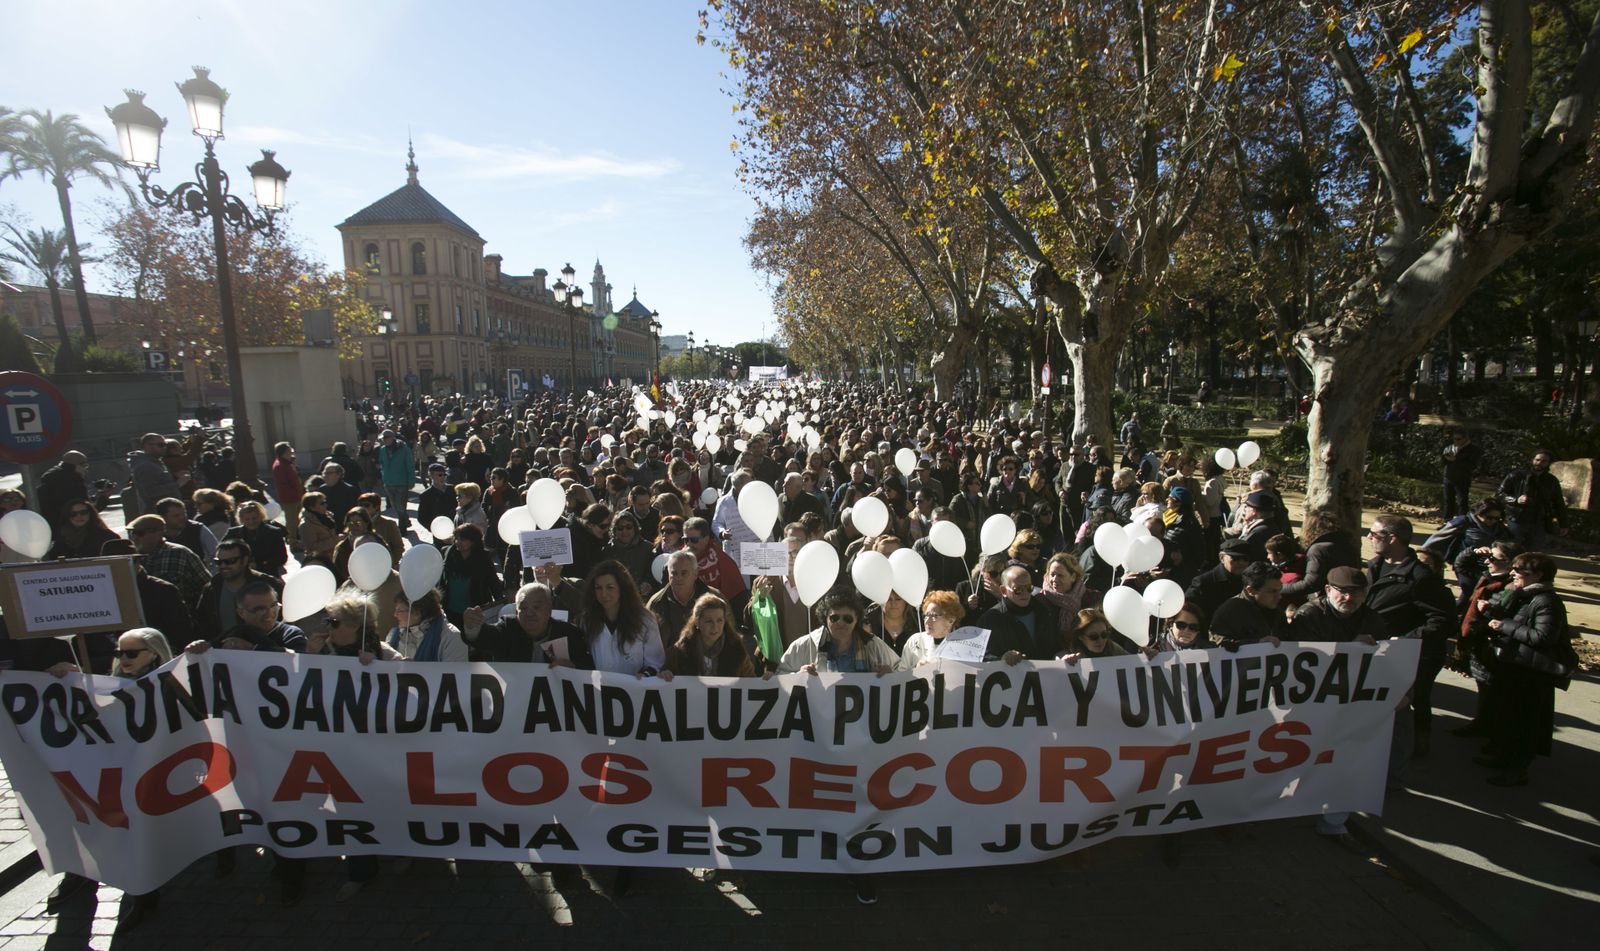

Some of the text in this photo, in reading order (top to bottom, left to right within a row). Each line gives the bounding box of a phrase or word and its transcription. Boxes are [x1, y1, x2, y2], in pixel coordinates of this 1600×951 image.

[150, 352, 165, 368] P
[511, 373, 520, 398] P
[14, 407, 36, 431] P
[16, 435, 41, 443] TAXIS
[59, 575, 80, 583] SALUD
[39, 584, 94, 597] SATURADO
[45, 614, 65, 622] UNA
[67, 610, 111, 620] RATONERA
[2, 651, 1390, 748] POR UNA SANIDAD ANDALUZA PUBLICA Y UNIVERSAL.
[51, 721, 1334, 830] NO A LOS RECORTES.
[219, 799, 1204, 861] POR UNA GESTIÓN JUSTA
